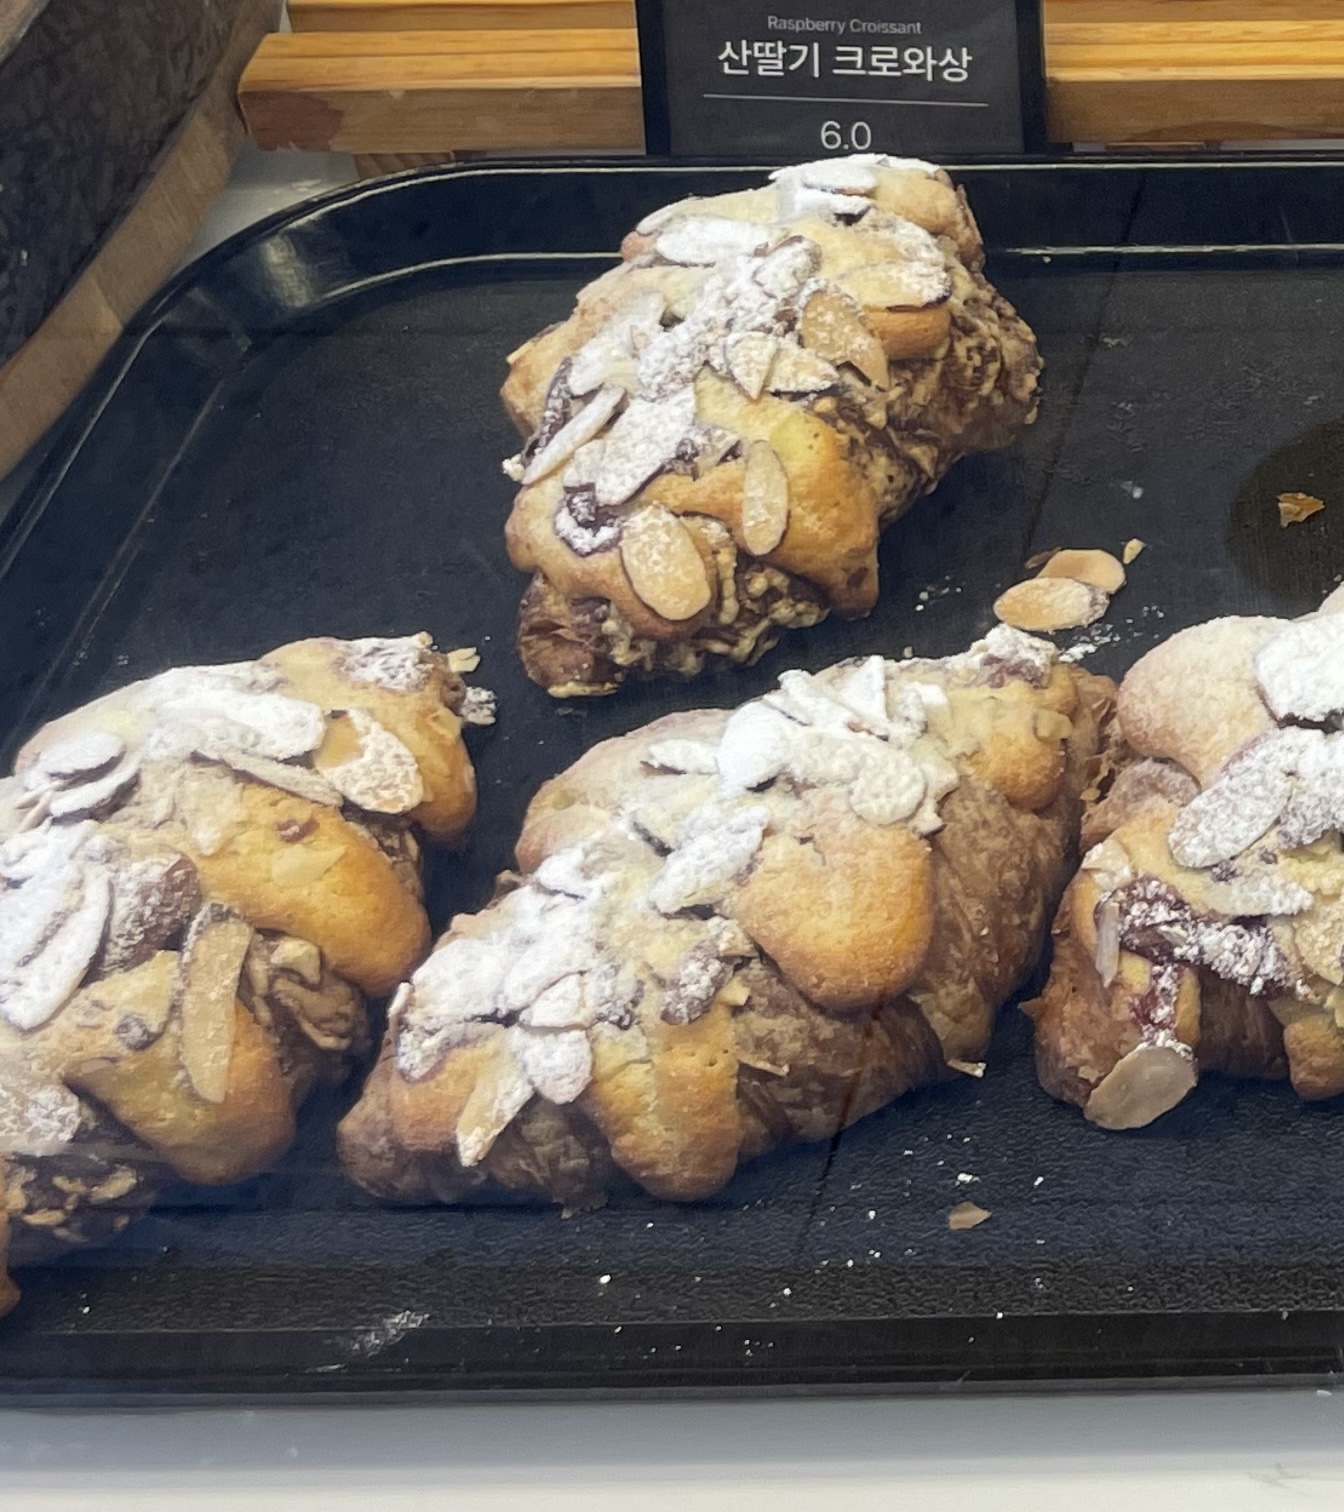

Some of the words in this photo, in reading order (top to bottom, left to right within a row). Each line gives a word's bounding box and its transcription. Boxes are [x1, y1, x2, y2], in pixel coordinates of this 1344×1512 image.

[767, 15, 846, 35] Raspberry
[849, 18, 922, 35] Croissant
[717, 38, 820, 78] 산딸기
[832, 45, 973, 83] 크로와상
[820, 120, 872, 151] 6.0
